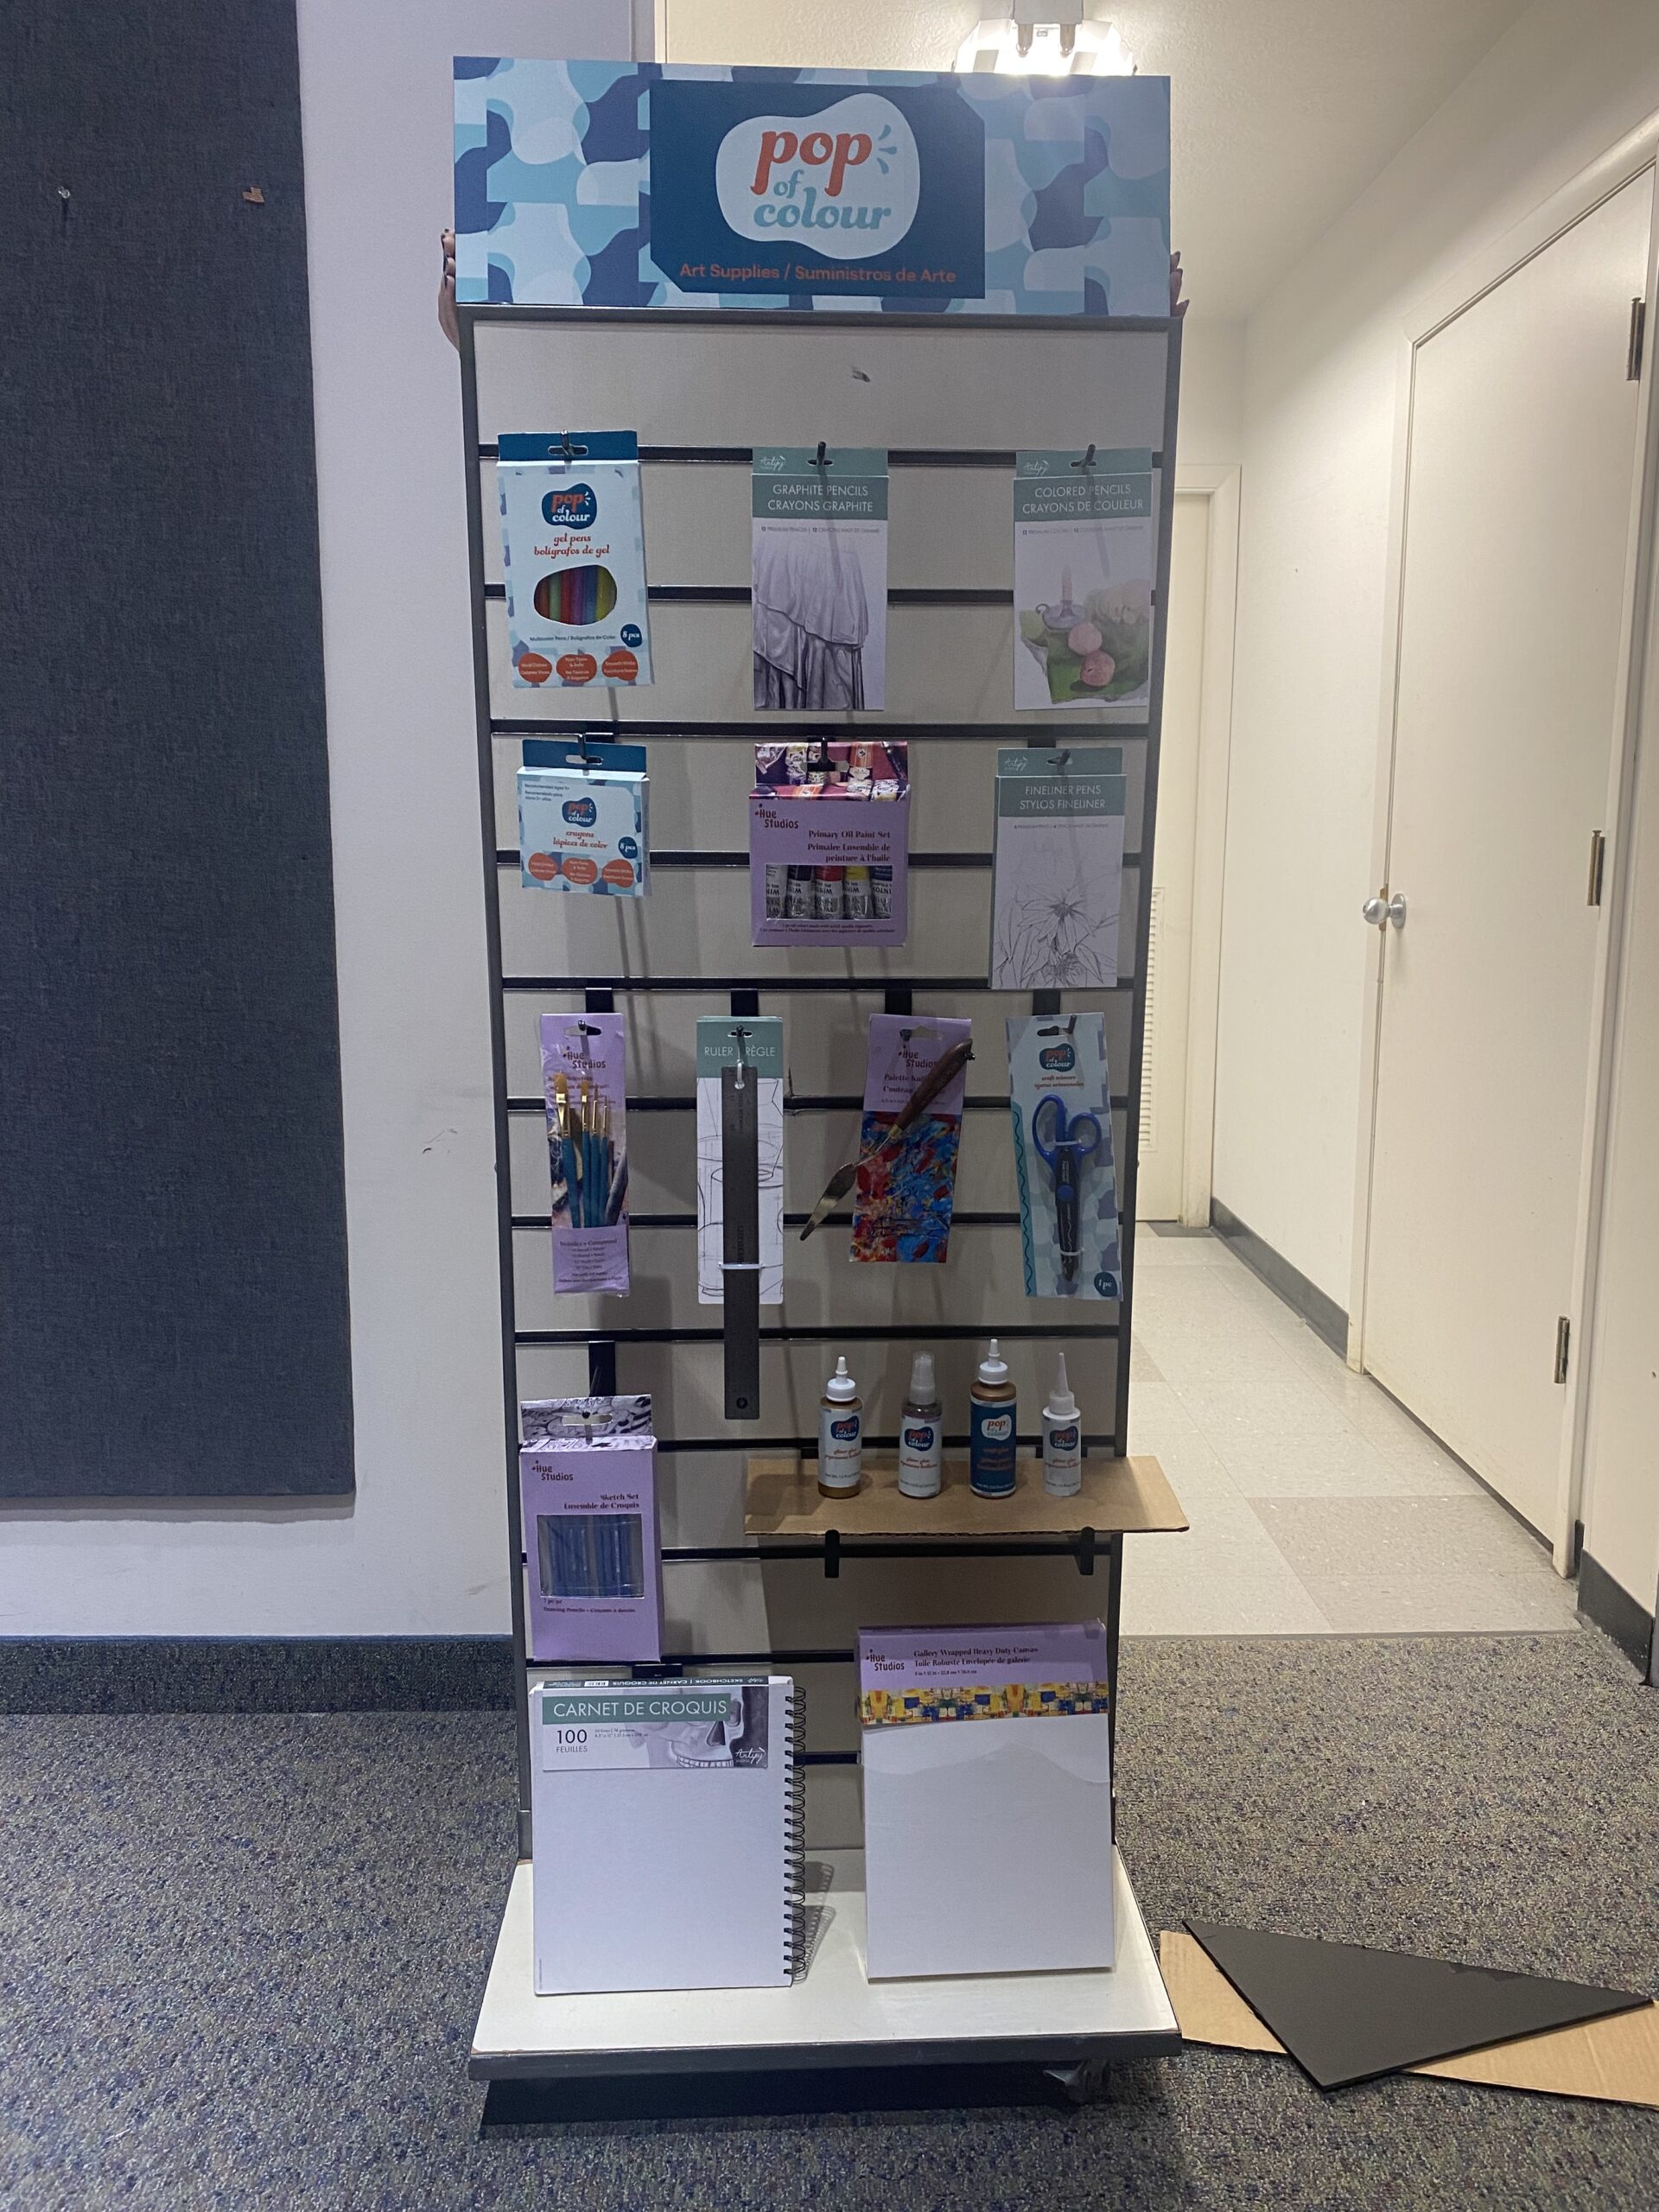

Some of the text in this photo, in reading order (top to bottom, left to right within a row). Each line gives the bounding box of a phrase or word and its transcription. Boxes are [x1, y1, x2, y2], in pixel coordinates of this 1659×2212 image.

[750, 131, 872, 197] pop
[773, 169, 804, 199] of
[753, 187, 892, 230] colour
[680, 263, 956, 283] Art Supplies / Suministros de Arte
[772, 484, 869, 496] GRAPHITE PENCILS
[1034, 484, 1131, 498] COLORED PENCILS
[550, 493, 584, 512] pop
[767, 499, 874, 512] CRAYONS GRAPHITE
[1022, 499, 1144, 514] CRAYONS DE COULEUR
[557, 505, 566, 514] of
[552, 509, 590, 523] colour
[554, 532, 591, 546] gel pens
[582, 544, 594, 555] de
[595, 544, 609, 558] gel
[1025, 785, 1102, 796] FINELINER PENS
[1020, 799, 1105, 810] STYLOS FINELINER
[568, 813, 593, 823] colour
[760, 809, 777, 818] Hue
[764, 818, 799, 829] Studios
[566, 831, 594, 840] crayons
[809, 830, 838, 839] Primary
[580, 839, 588, 848] de
[825, 855, 858, 863] peinture
[704, 1045, 776, 1057] RULER RÈGLE
[572, 1060, 607, 1069] Studios
[906, 1058, 934, 1068] Studio
[1046, 1059, 1071, 1068] colour
[987, 1421, 1006, 1431] pop
[536, 1465, 553, 1473] Hue
[541, 1472, 574, 1481] Studios
[939, 1648, 972, 1657] Wrapped
[869, 1654, 886, 1662] Hue
[932, 1658, 961, 1667] Robuste
[874, 1662, 905, 1671] Studios
[553, 1700, 727, 1717] CARNET DE CROQUIS
[556, 1729, 588, 1745] 100
[556, 1745, 588, 1753] FEUILLES
